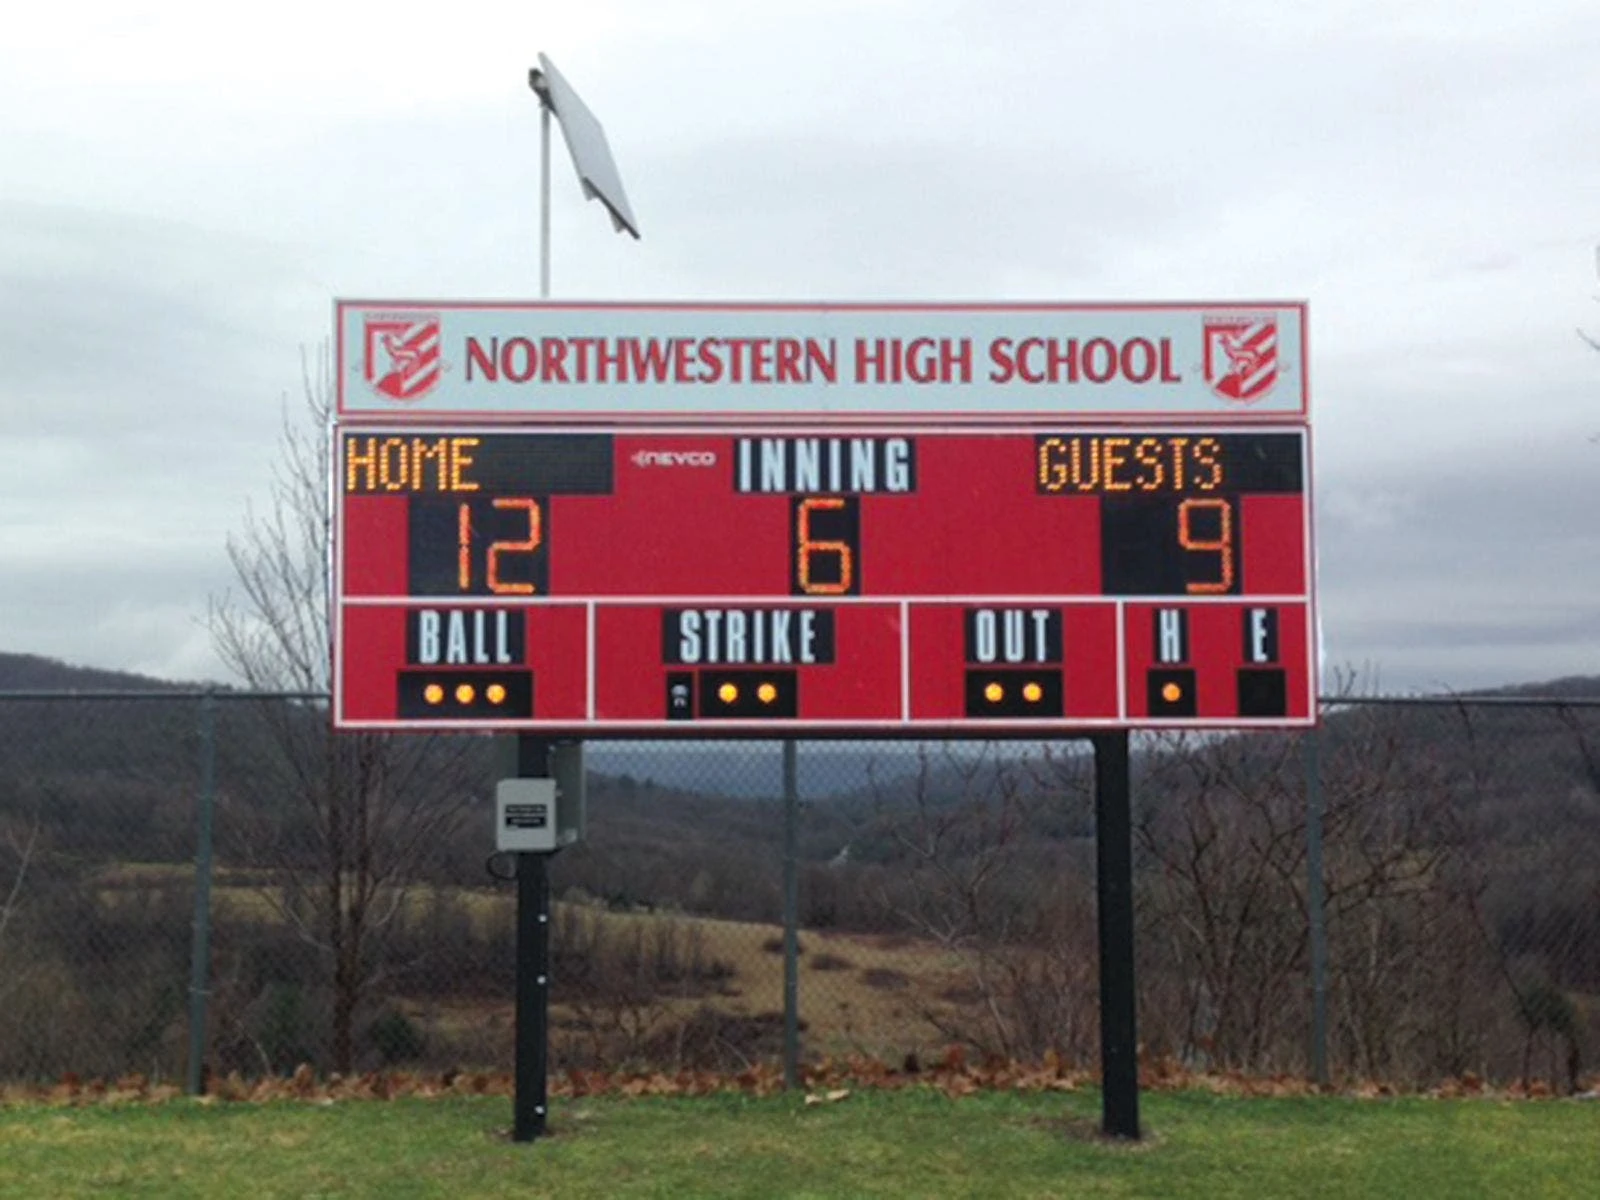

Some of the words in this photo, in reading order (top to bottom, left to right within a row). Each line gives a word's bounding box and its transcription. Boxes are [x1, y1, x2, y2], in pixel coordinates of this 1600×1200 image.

[465, 336, 837, 384] NORTHWESTERN
[854, 336, 972, 384] HIGH
[988, 336, 1182, 384] SCHOOL
[346, 437, 480, 492] HOME
[739, 438, 909, 492] INNING
[1037, 437, 1223, 491] GUESTS
[457, 497, 541, 593] 12
[797, 497, 852, 594] 6
[1177, 497, 1233, 593] 9
[418, 609, 511, 664] BALL
[679, 609, 816, 664] STRIKE
[975, 609, 1049, 663] OUT
[1159, 609, 1181, 662] H
[1252, 609, 1268, 662] E
